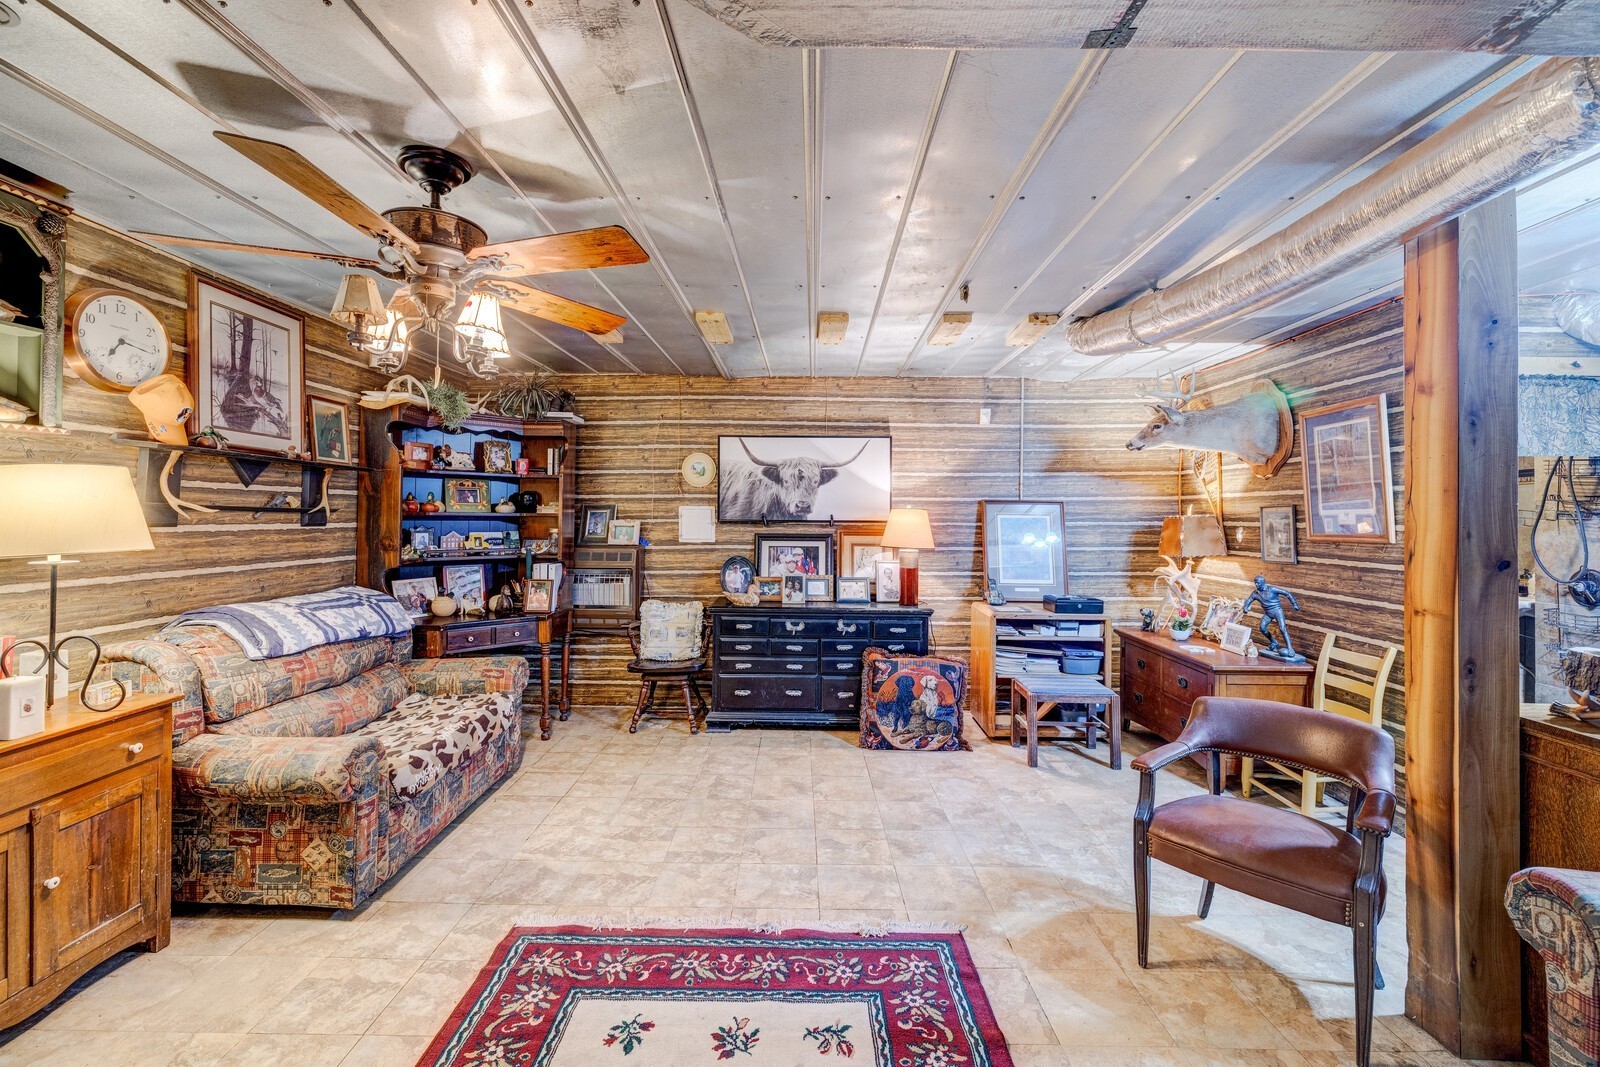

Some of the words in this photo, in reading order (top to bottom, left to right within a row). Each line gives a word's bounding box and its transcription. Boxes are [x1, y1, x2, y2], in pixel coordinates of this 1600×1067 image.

[98, 302, 107, 315] 11
[115, 302, 126, 315] 12
[85, 312, 96, 324] 10
[134, 312, 139, 323] 1
[79, 328, 86, 338] 9
[146, 327, 152, 338] 2
[84, 348, 91, 358] 8
[152, 345, 157, 354] 3
[99, 364, 105, 373] 7
[116, 371, 123, 380] 6
[135, 371, 140, 379] 5
[415, 761, 434, 781] DUCK
[408, 763, 441, 794] DYNASTY
